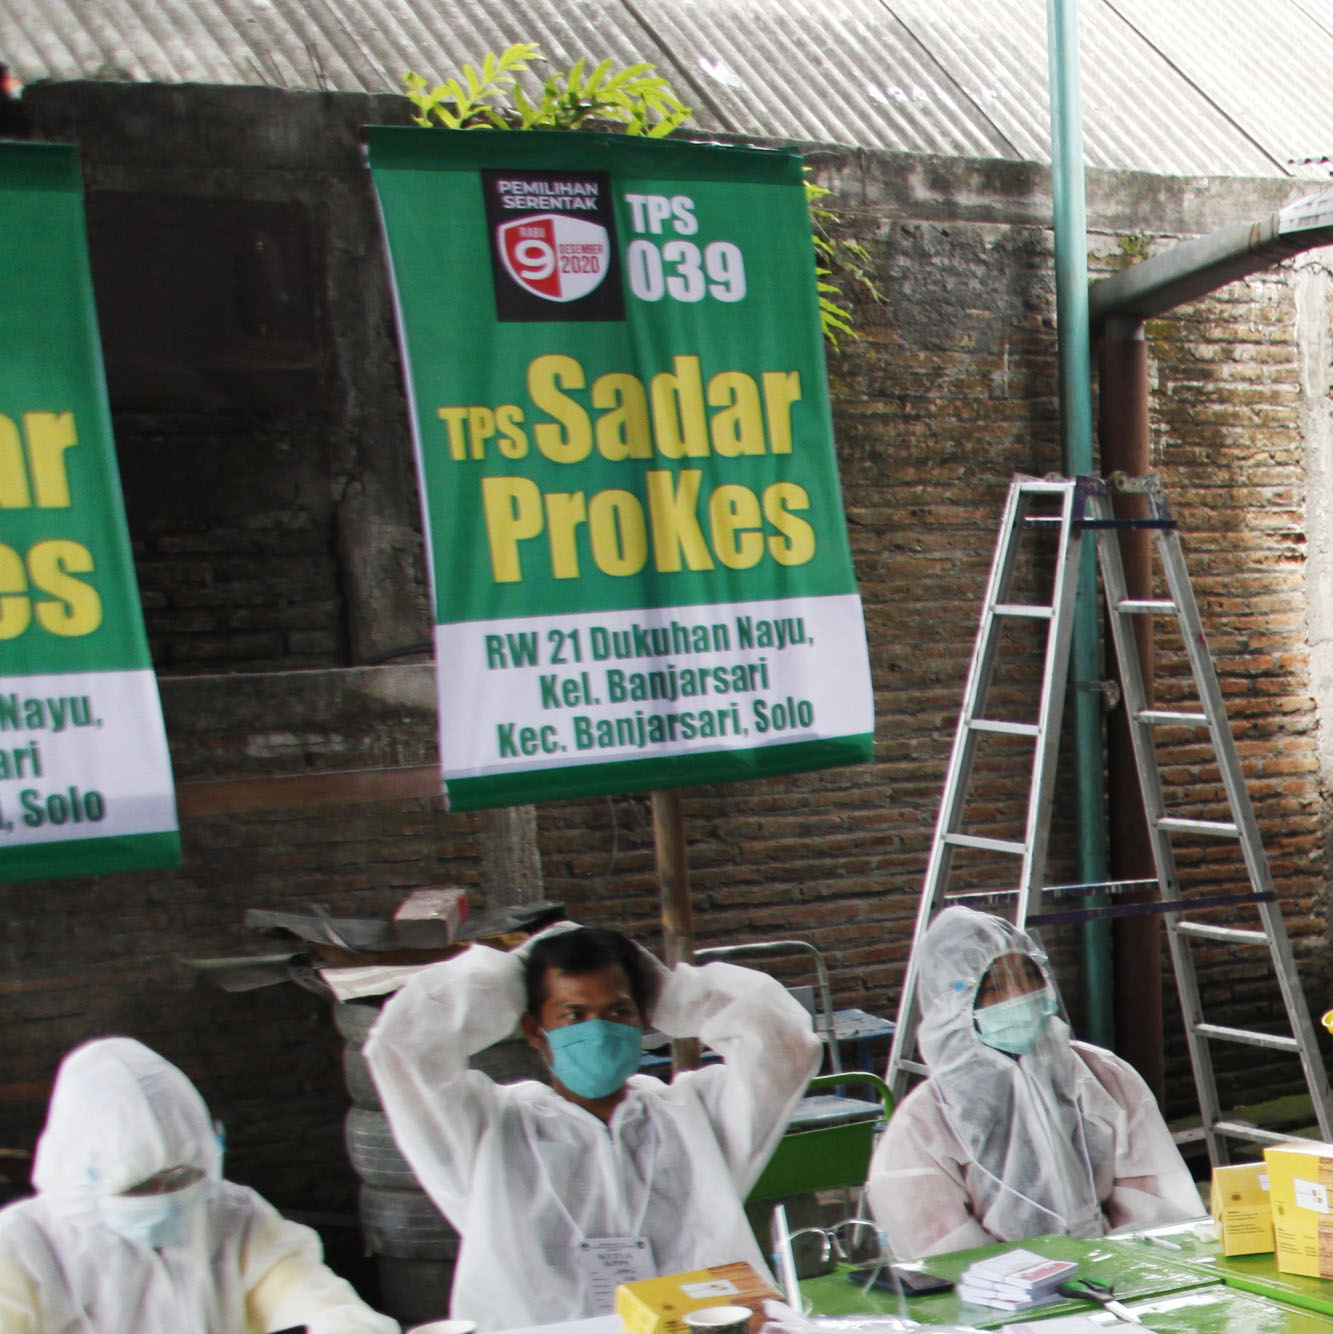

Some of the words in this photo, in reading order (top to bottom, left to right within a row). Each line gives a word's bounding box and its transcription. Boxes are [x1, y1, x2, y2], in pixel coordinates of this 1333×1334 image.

[497, 179, 599, 197] PEMILIHAN
[503, 195, 598, 211] SERENTAK
[625, 193, 698, 236] TPS
[514, 239, 556, 281] 9
[559, 243, 603, 255] DESEMBER
[560, 255, 600, 274] 2020
[626, 239, 748, 303] 039
[437, 404, 529, 461] TPS
[526, 353, 802, 465] Sadar
[481, 469, 816, 583] ProKes
[484, 630, 539, 670] RW
[546, 628, 582, 665] 21
[588, 621, 732, 662] Dukuhan
[735, 615, 815, 651] Nayu,
[538, 672, 601, 710] Kel.
[605, 657, 771, 704] Banjarsari
[495, 723, 568, 759] Kec.
[571, 702, 749, 751] Banjarsari,
[754, 696, 816, 733] Solo
[19, 785, 107, 829] Solo
